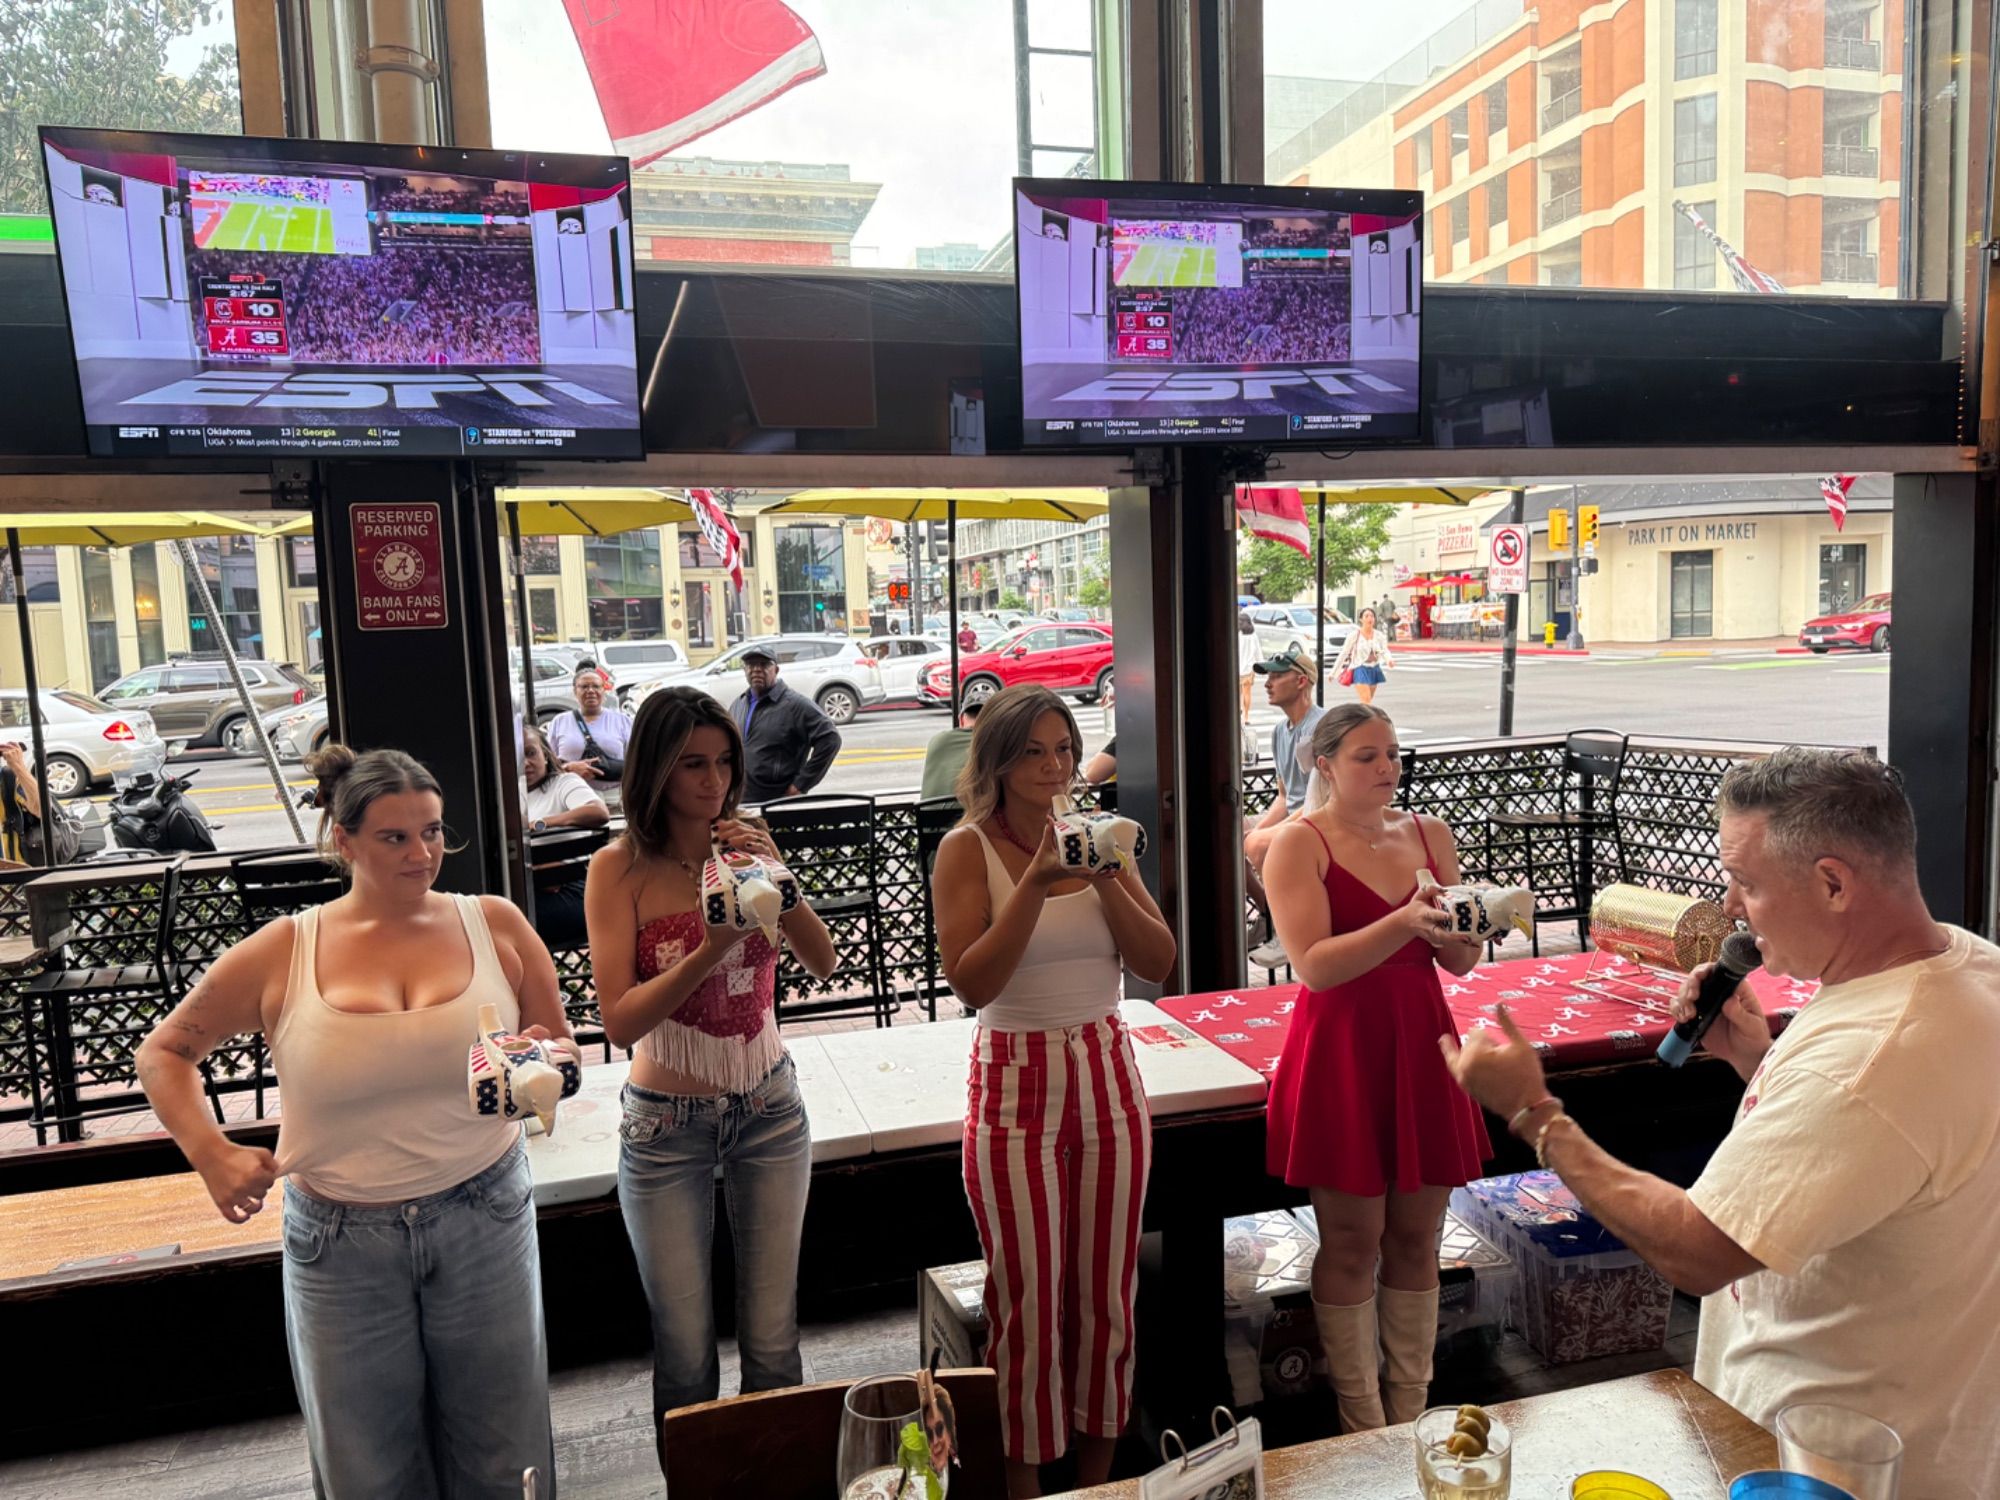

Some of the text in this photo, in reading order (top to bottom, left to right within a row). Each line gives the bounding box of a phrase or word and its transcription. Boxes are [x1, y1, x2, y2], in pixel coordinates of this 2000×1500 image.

[248, 303, 274, 316] 10
[1146, 316, 1165, 327] 10
[251, 331, 279, 344] 35
[1146, 339, 1166, 350] 35
[120, 371, 624, 409] ESPN
[1053, 368, 1406, 400] ESPN
[1046, 421, 1074, 430] ESPN
[1174, 419, 1199, 428] Georgia
[119, 427, 159, 438] ESPN
[207, 427, 252, 436] Oklahoma
[281, 428, 291, 436] 13
[302, 428, 337, 438] Georgia
[367, 428, 378, 437] 41
[382, 429, 400, 437] Final
[256, 439, 280, 447] points
[281, 439, 310, 447] through
[357, 511, 433, 523] RESERVED
[364, 524, 428, 537] PARKING
[1628, 522, 1757, 545] PARK IT ON MARKET
[388, 556, 409, 576] A
[363, 595, 441, 608] BAMA FANS
[385, 609, 420, 622] ONLY
